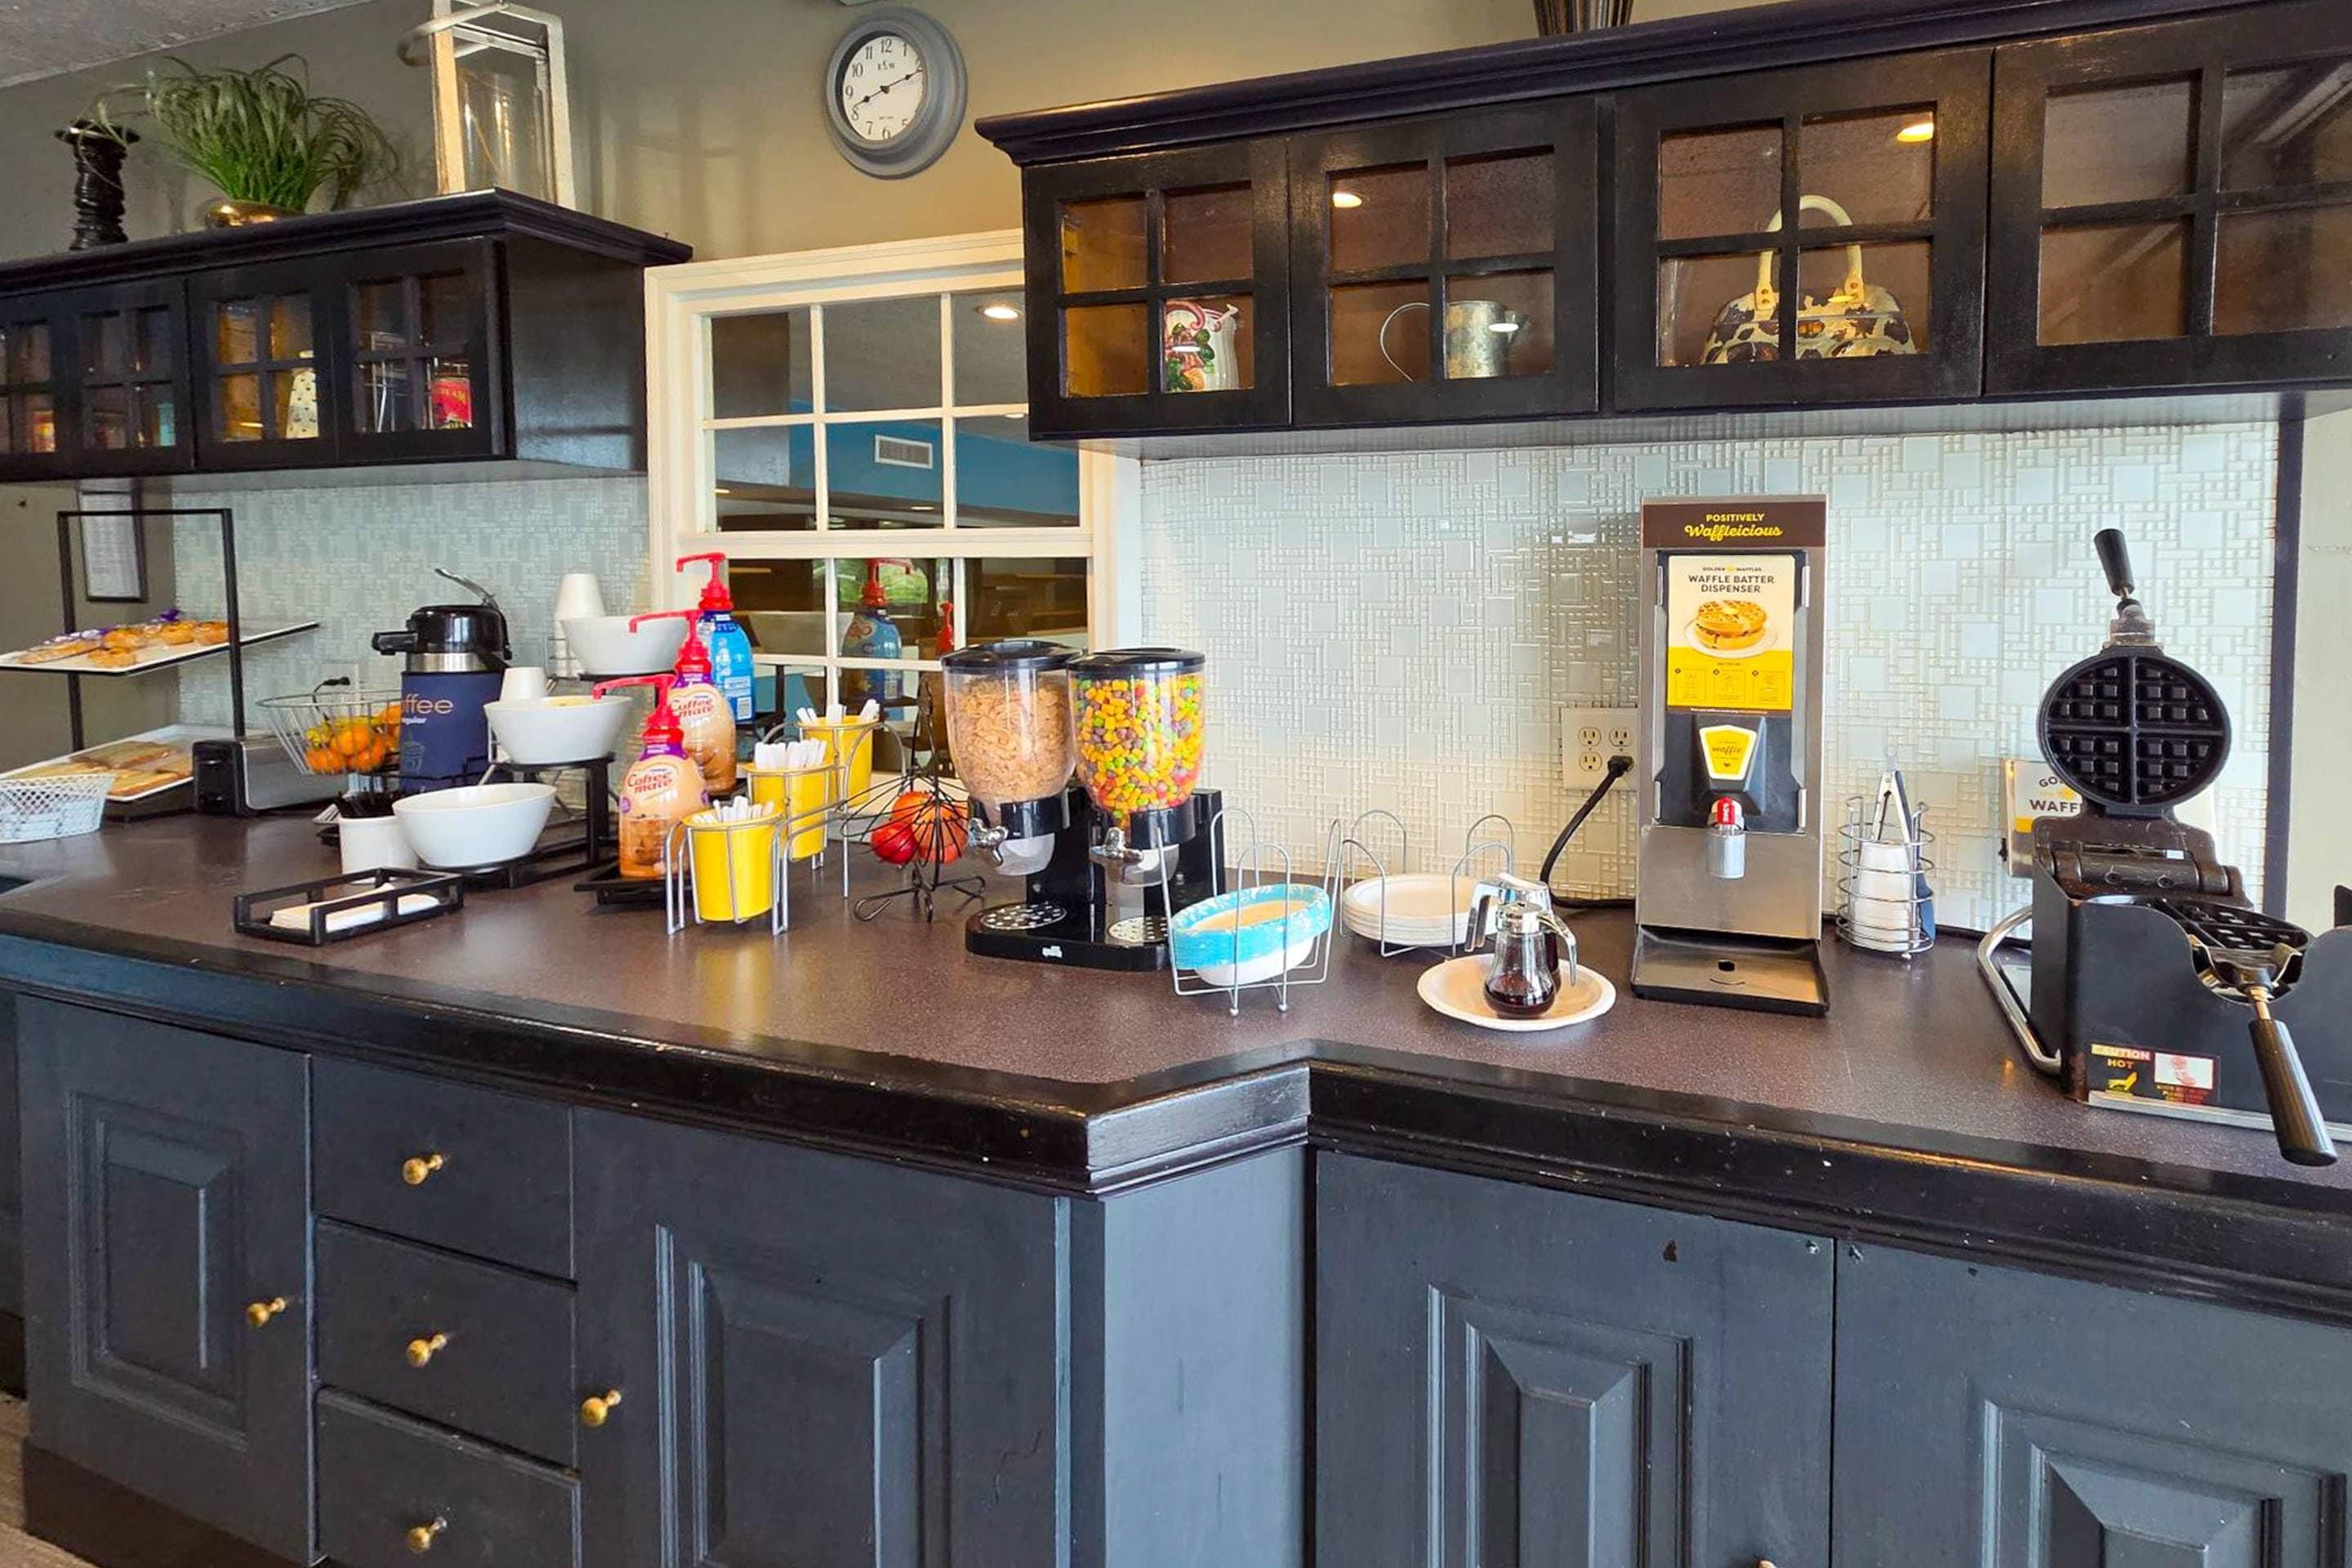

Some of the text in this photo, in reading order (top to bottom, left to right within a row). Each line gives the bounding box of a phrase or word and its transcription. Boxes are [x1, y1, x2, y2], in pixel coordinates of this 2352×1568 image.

[865, 46, 874, 60] 11
[880, 39, 893, 54] 12
[902, 42, 908, 57] 1
[851, 63, 864, 78] 10
[844, 86, 854, 100] 9
[851, 105, 860, 122] 8
[866, 121, 874, 136] 7
[882, 126, 892, 140] 6
[1705, 513, 1765, 523] POSITIVELY
[1684, 523, 1784, 541] Waffleicious
[1688, 574, 1775, 584] WAFFLE BATTER
[1700, 584, 1762, 594] DISPENSER
[404, 693, 454, 715] ffee
[2029, 799, 2078, 814] WAFF
[2107, 1058, 2135, 1070] HOT
